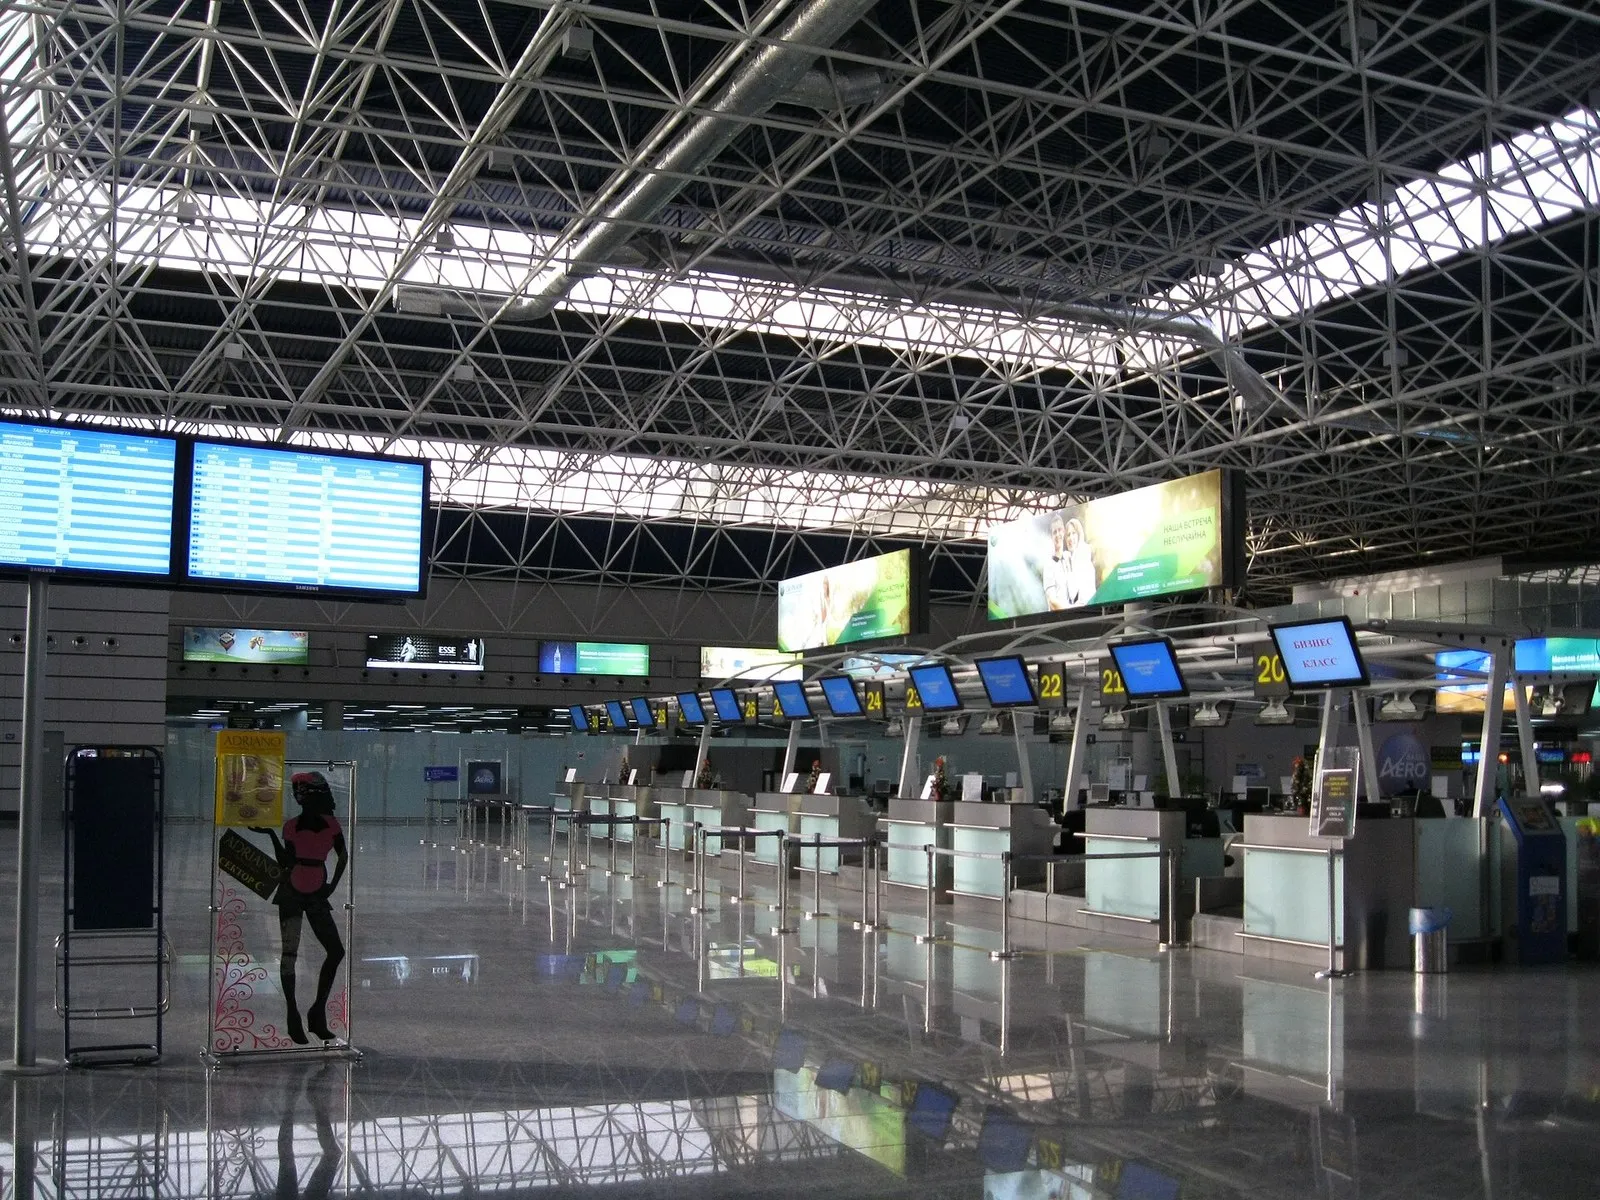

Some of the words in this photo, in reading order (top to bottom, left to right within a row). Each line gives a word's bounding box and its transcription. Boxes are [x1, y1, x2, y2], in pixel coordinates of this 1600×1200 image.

[438, 646, 457, 654] ESSE
[1293, 637, 1333, 649] БИЗНЕС
[1257, 655, 1285, 683] 20
[1302, 657, 1338, 668] КЛАСС
[1041, 673, 1062, 697] 22
[1102, 668, 1125, 694] 21
[745, 701, 756, 718] 26
[773, 699, 783, 716] 2
[867, 691, 882, 711] 24
[223, 735, 282, 748] ADRIANO
[223, 834, 282, 880] ADRIANO
[219, 856, 255, 885] СЕКТОР
